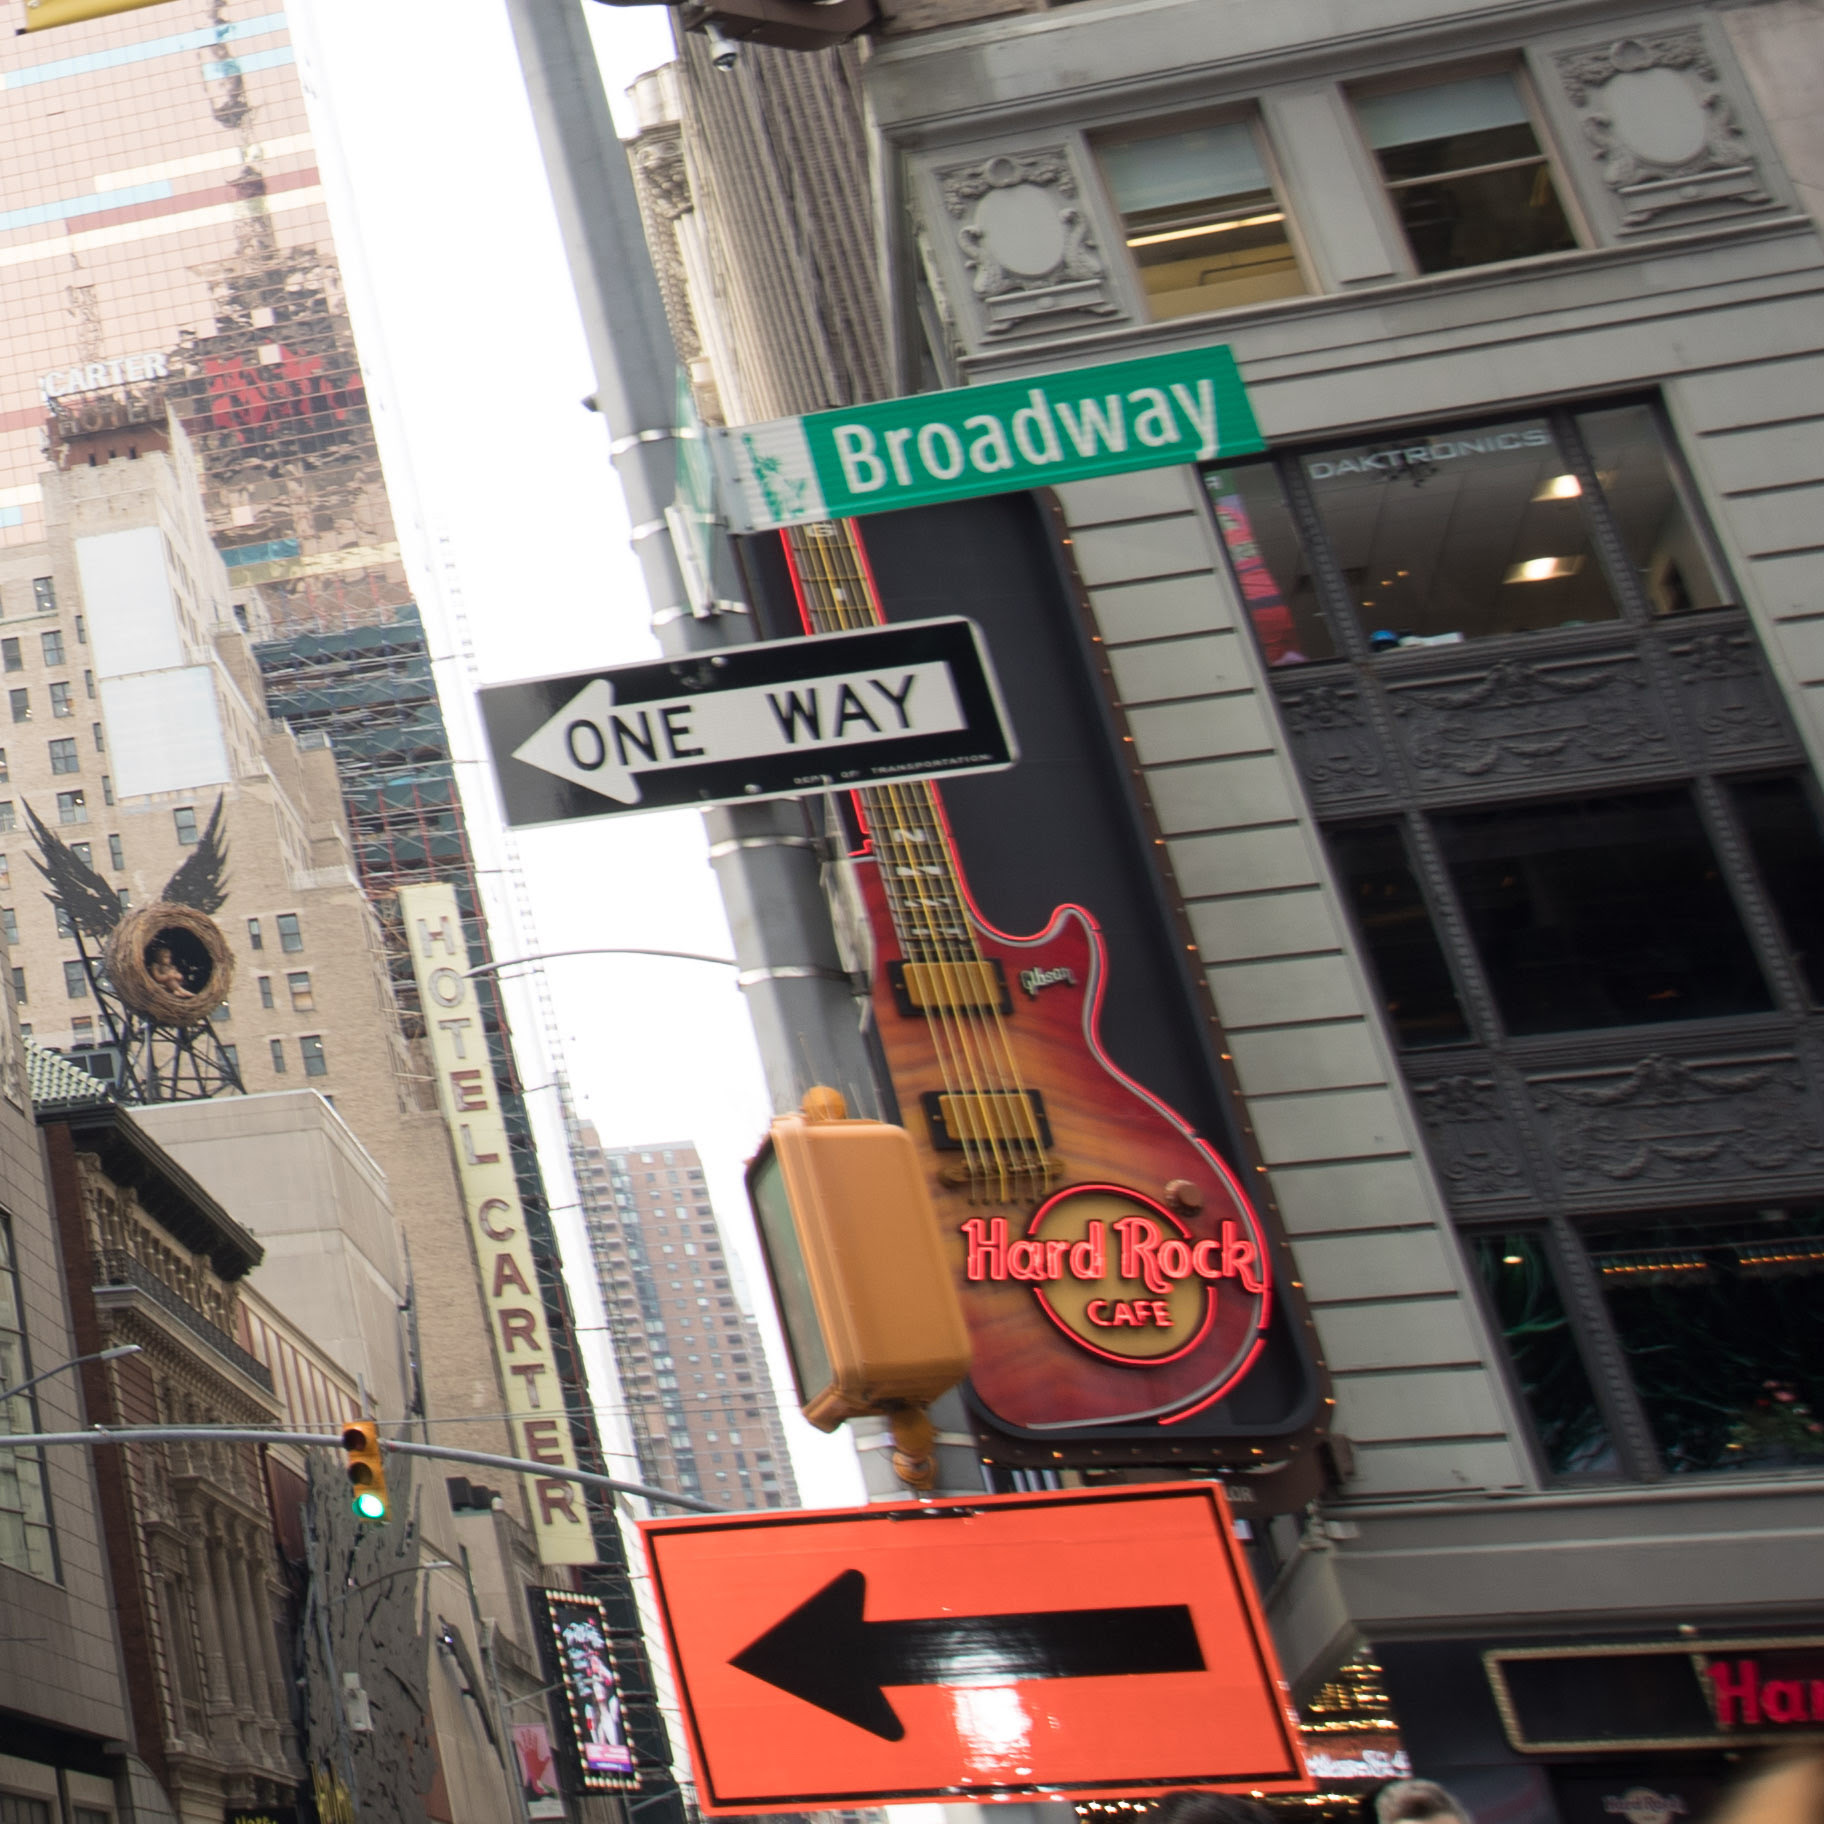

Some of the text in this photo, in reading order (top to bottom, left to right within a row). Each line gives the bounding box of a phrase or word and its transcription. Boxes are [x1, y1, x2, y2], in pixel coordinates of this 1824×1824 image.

[44, 352, 170, 397] CARTER
[832, 378, 1220, 494] Broadway
[1307, 428, 1552, 480] DAKTRONICS
[564, 674, 918, 772] ONE WAY
[416, 915, 581, 1526] HOTEL CARTER
[961, 1216, 1265, 1294] Hard Rock
[1086, 1299, 1175, 1327] CAFE
